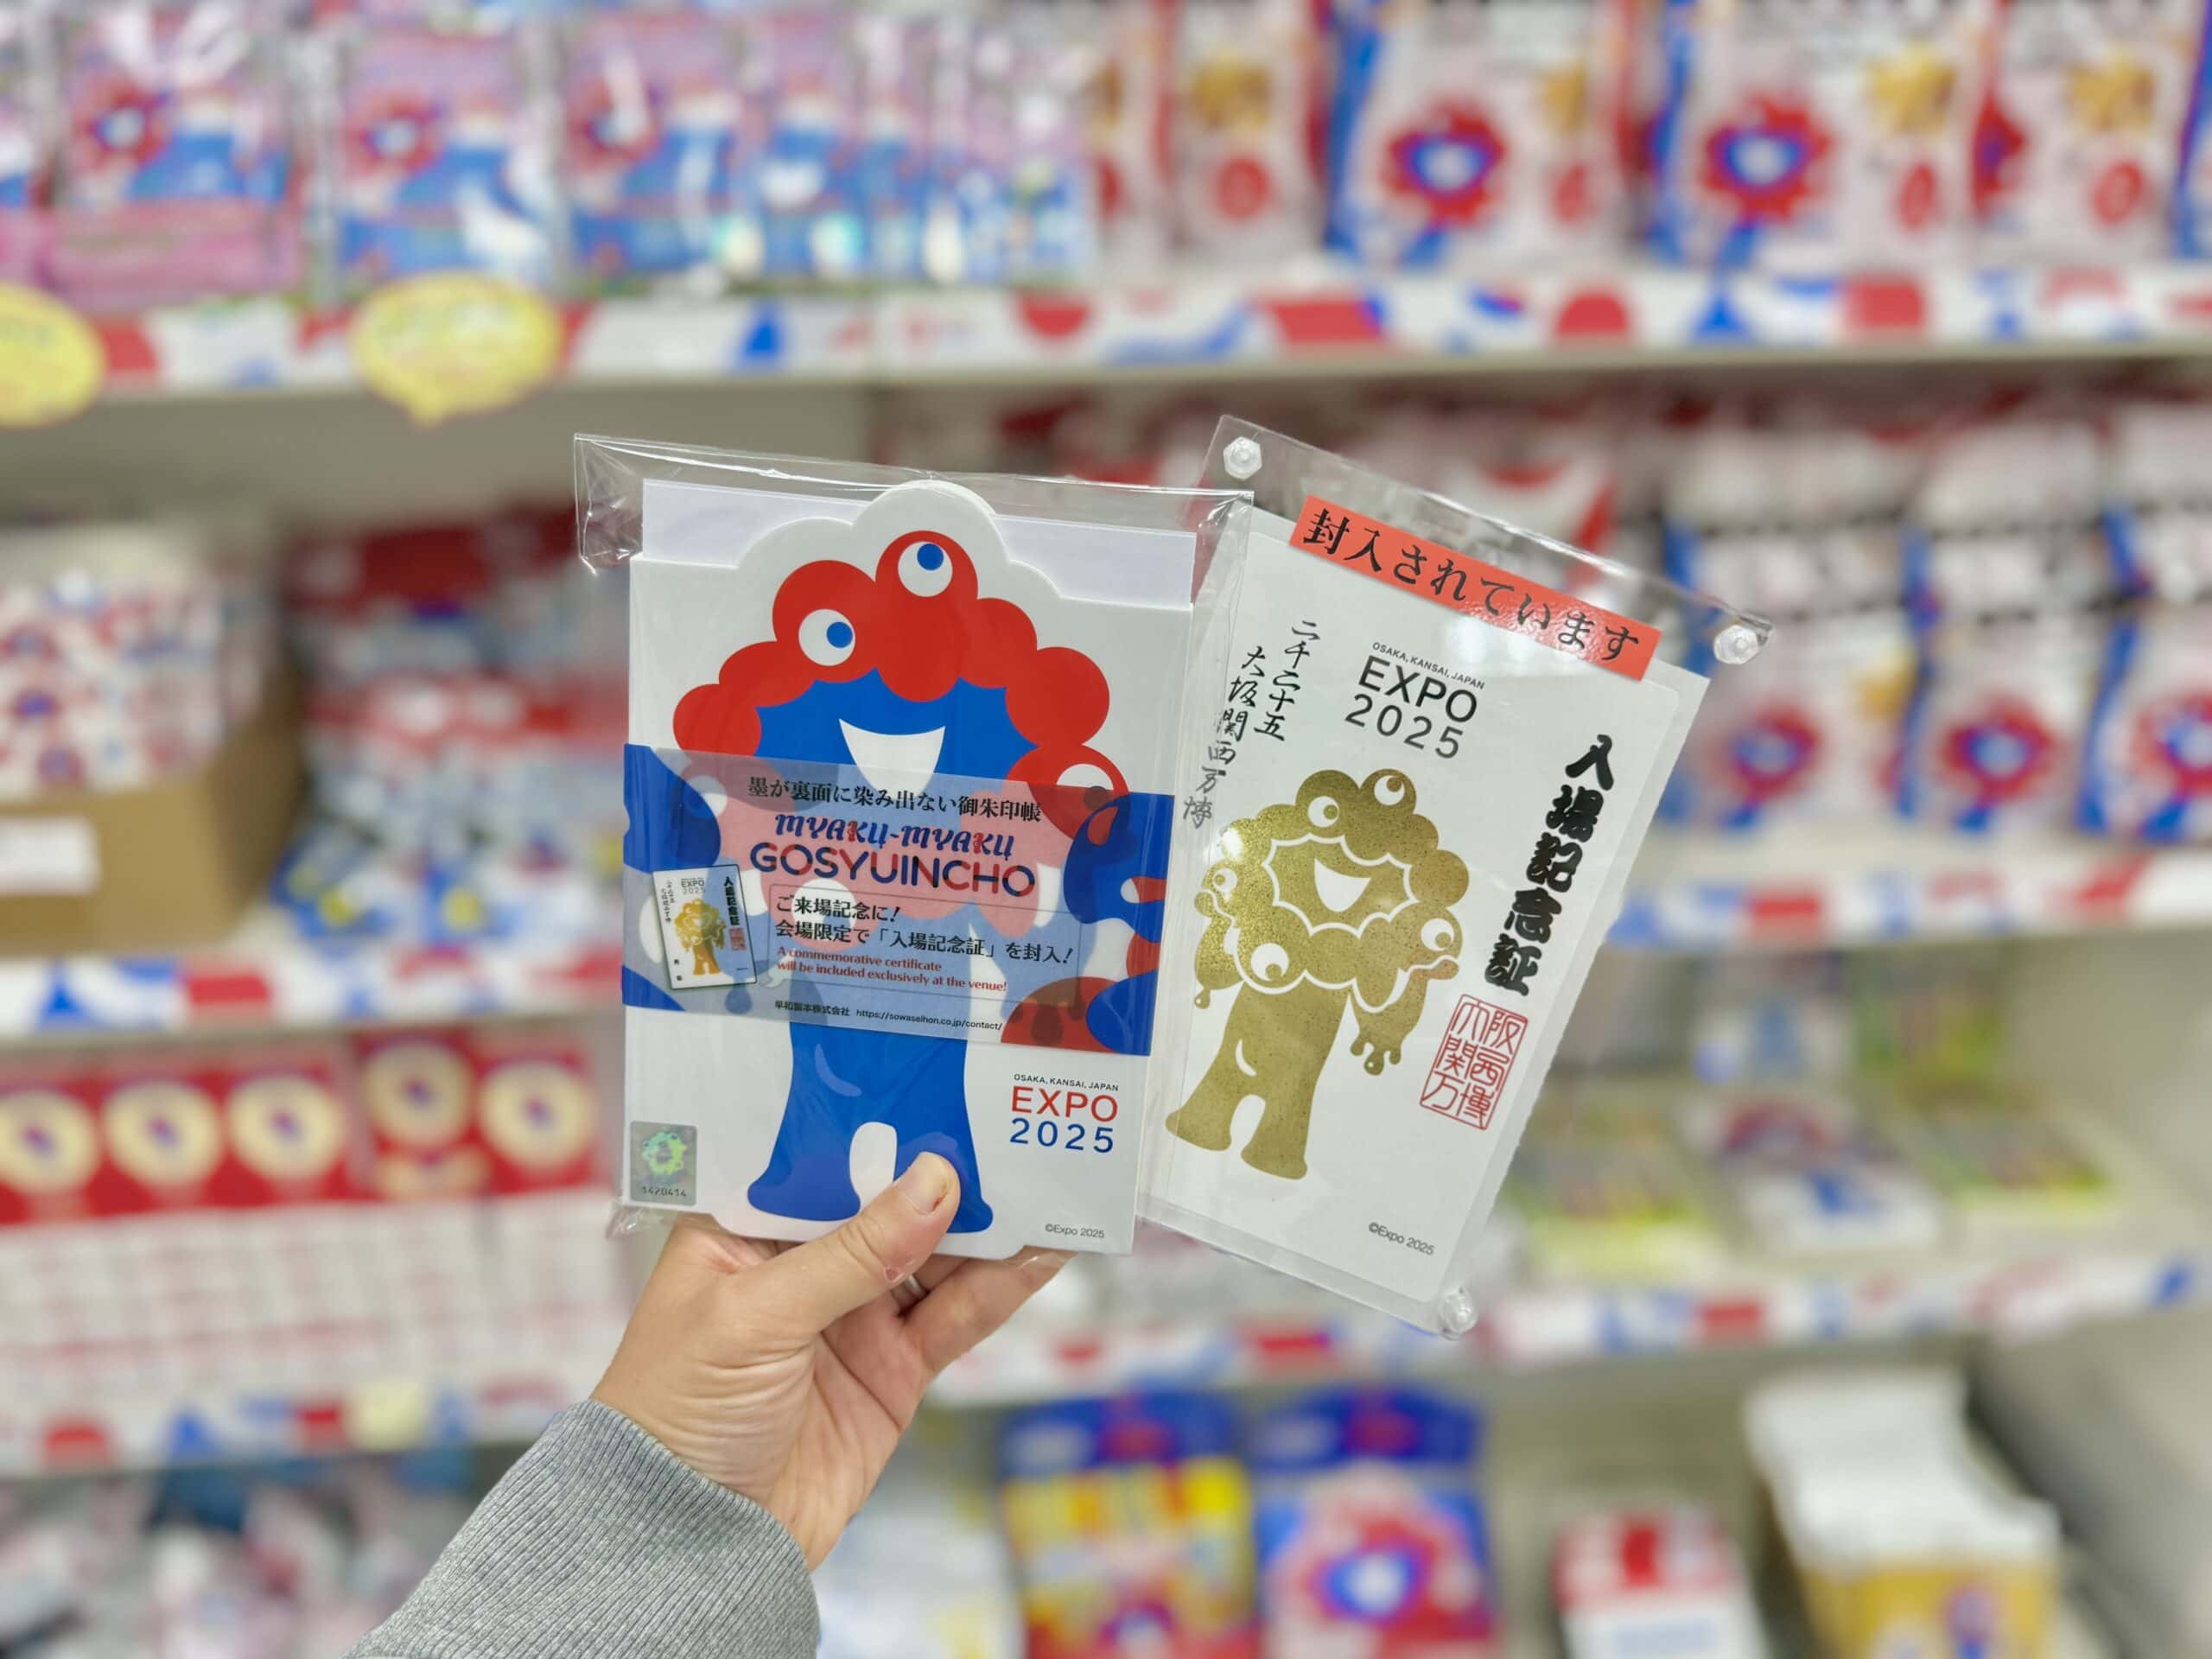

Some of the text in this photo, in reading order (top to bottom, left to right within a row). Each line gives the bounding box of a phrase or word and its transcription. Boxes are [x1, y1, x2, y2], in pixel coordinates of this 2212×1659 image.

[1302, 507, 1640, 662] 封入されています
[1253, 620, 1321, 741] 二千二十五
[1358, 655, 1478, 722] EXPO
[1372, 642, 1485, 690] OSAKA, KANSAI, JAPAN
[1344, 693, 1464, 760] 2025
[747, 777, 1042, 823] 墨が裏面に染み出ない御朱印帳
[774, 813, 1015, 861] MYAKU-MYAKU
[749, 842, 1036, 897] GOSYUINCHO
[1484, 734, 1615, 997] 入場記念証
[777, 893, 901, 923] ご来場記念に!
[778, 946, 942, 972] A commemorative certificate
[778, 960, 1007, 992] will be included exclusively at the venue!
[1011, 1085, 1118, 1122] EXPO
[1014, 1073, 1119, 1091] OSAKA, KANSAI, JAPAN
[1009, 1117, 1114, 1154] 2025
[1045, 1224, 1105, 1239] ©Expo 2025
[1405, 1236, 1436, 1256] 2025
